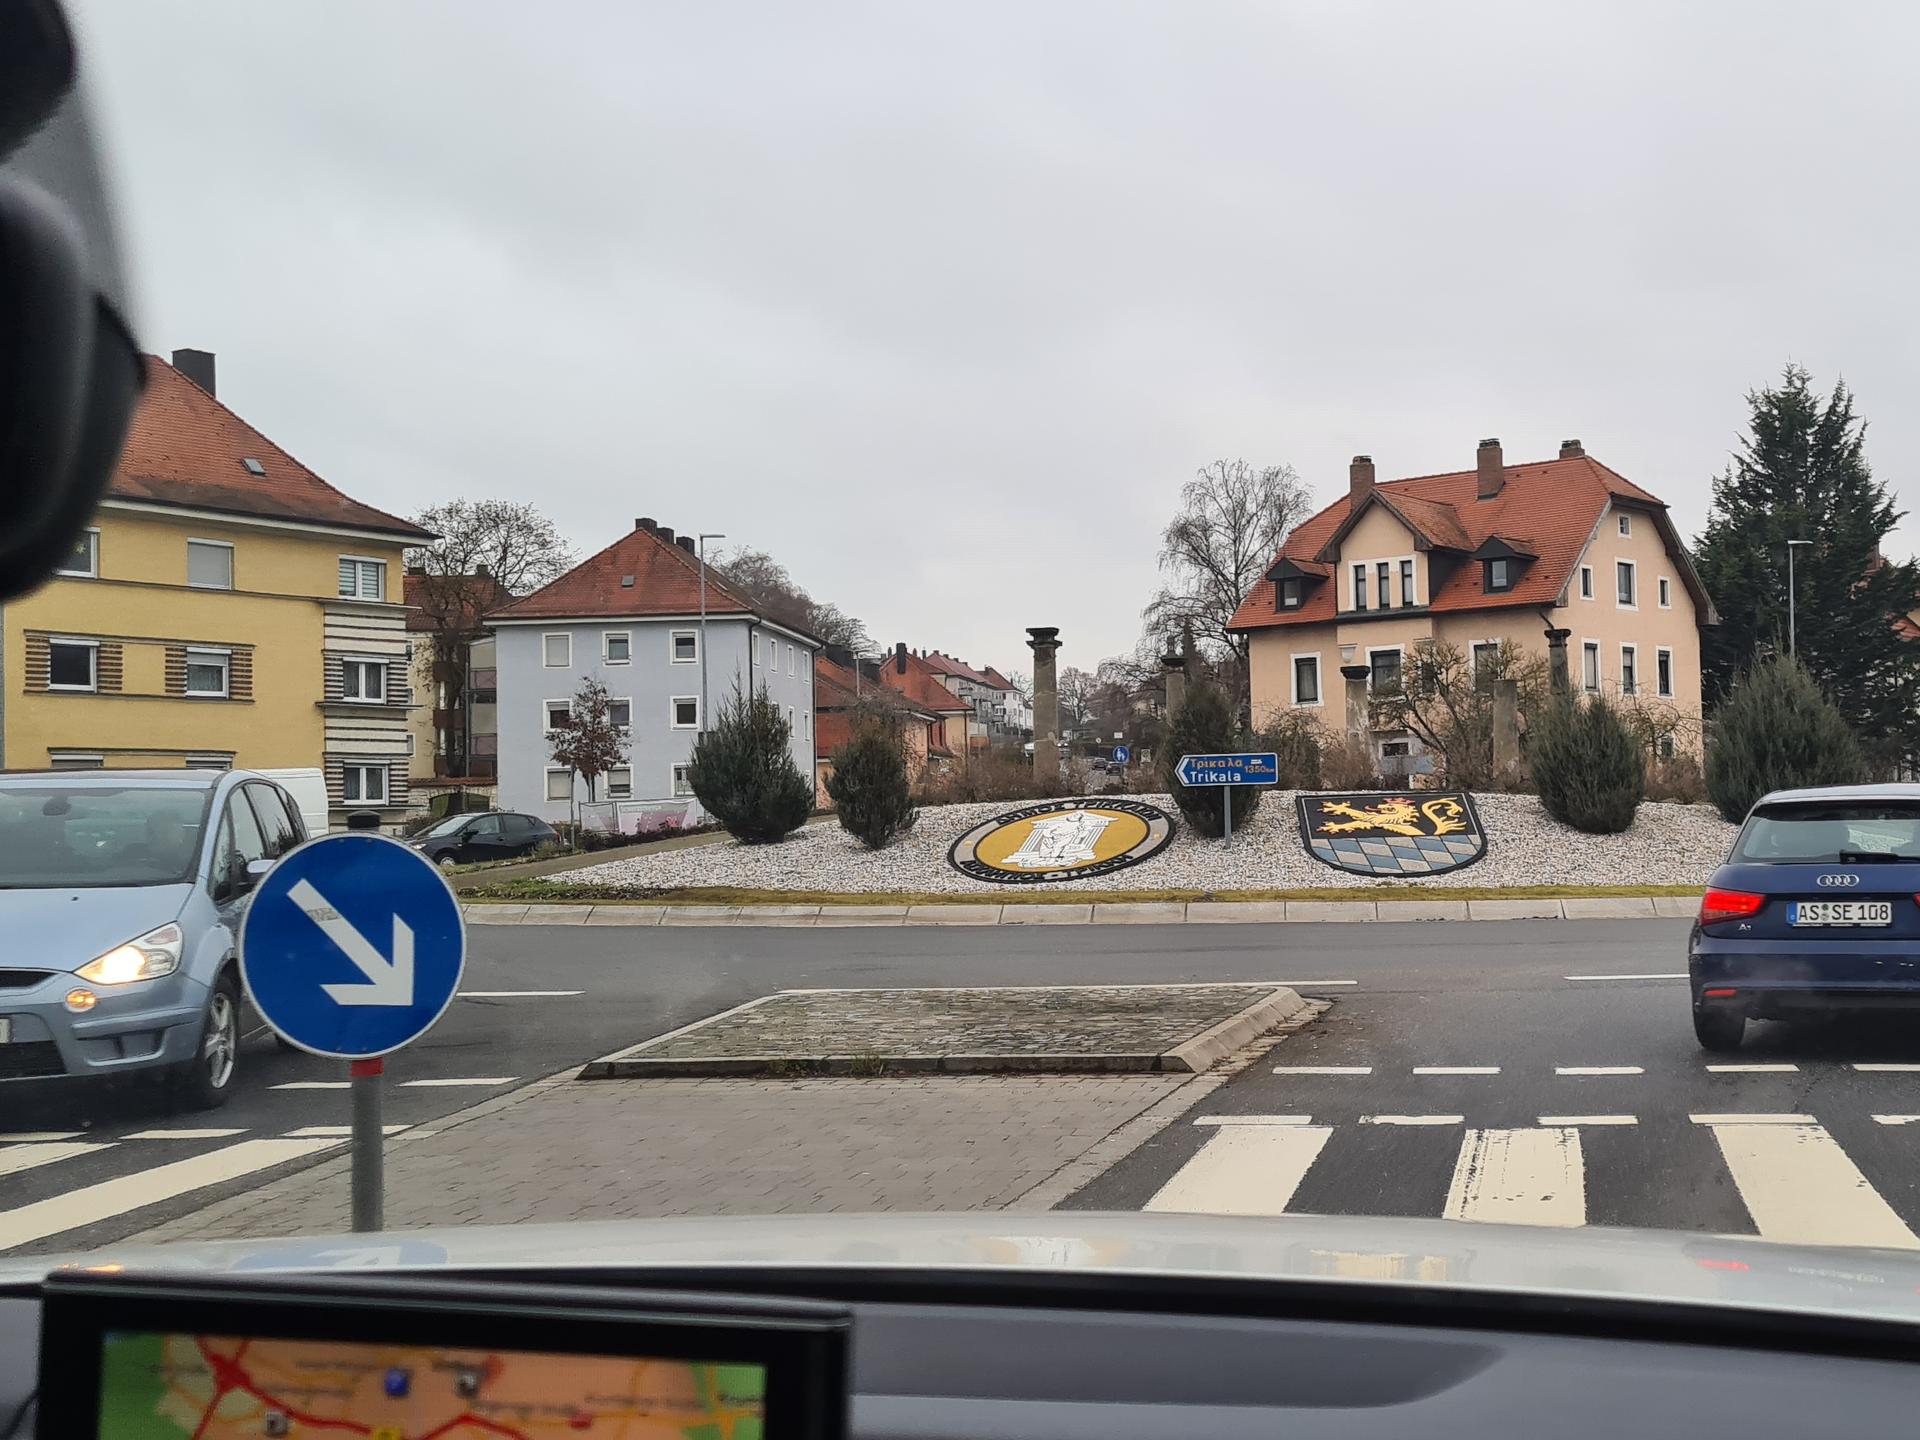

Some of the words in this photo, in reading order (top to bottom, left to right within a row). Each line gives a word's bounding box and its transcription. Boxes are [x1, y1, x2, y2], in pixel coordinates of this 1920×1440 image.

[1190, 770, 1241, 782] Trikala
[1799, 904, 1819, 921] AS
[1831, 904, 1853, 921] SE
[1857, 904, 1889, 921] 108
